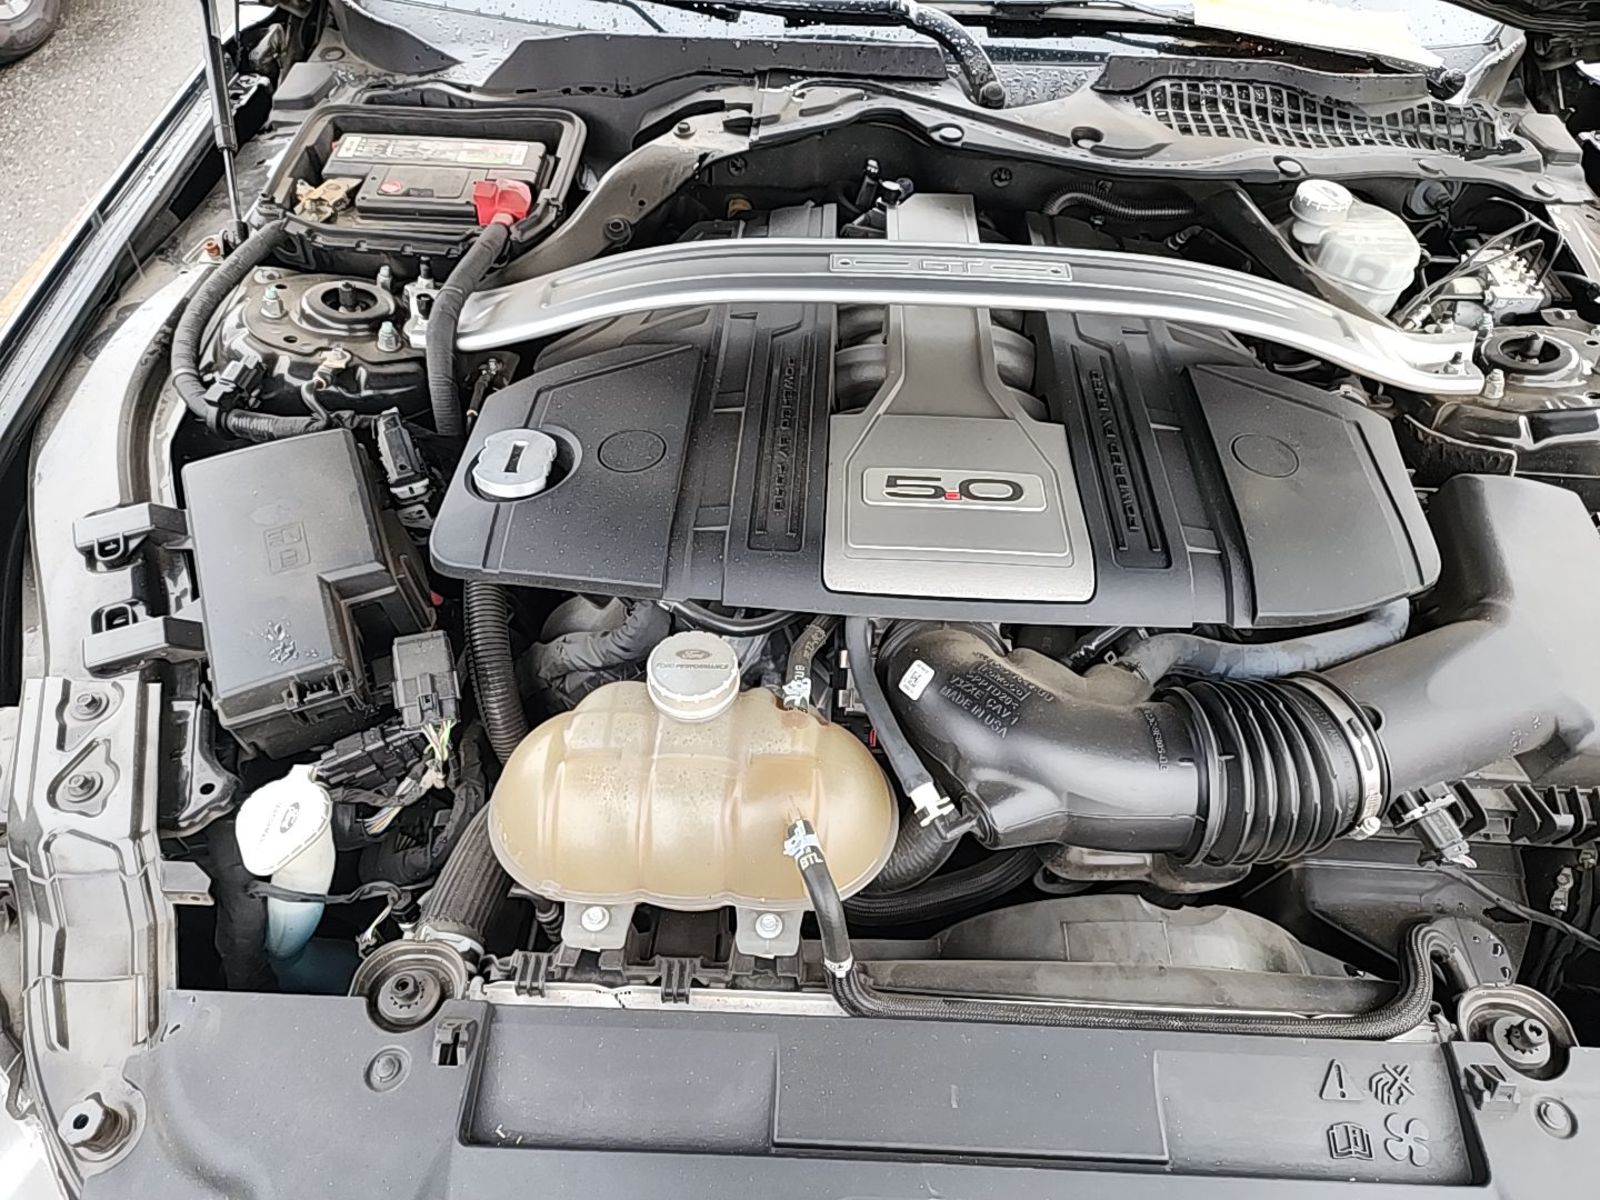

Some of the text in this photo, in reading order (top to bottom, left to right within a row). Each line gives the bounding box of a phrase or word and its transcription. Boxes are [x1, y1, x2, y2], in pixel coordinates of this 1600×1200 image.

[884, 474, 1024, 502] 5.0
[939, 683, 1007, 738] MADE IN USA
[800, 852, 824, 871] BTL
